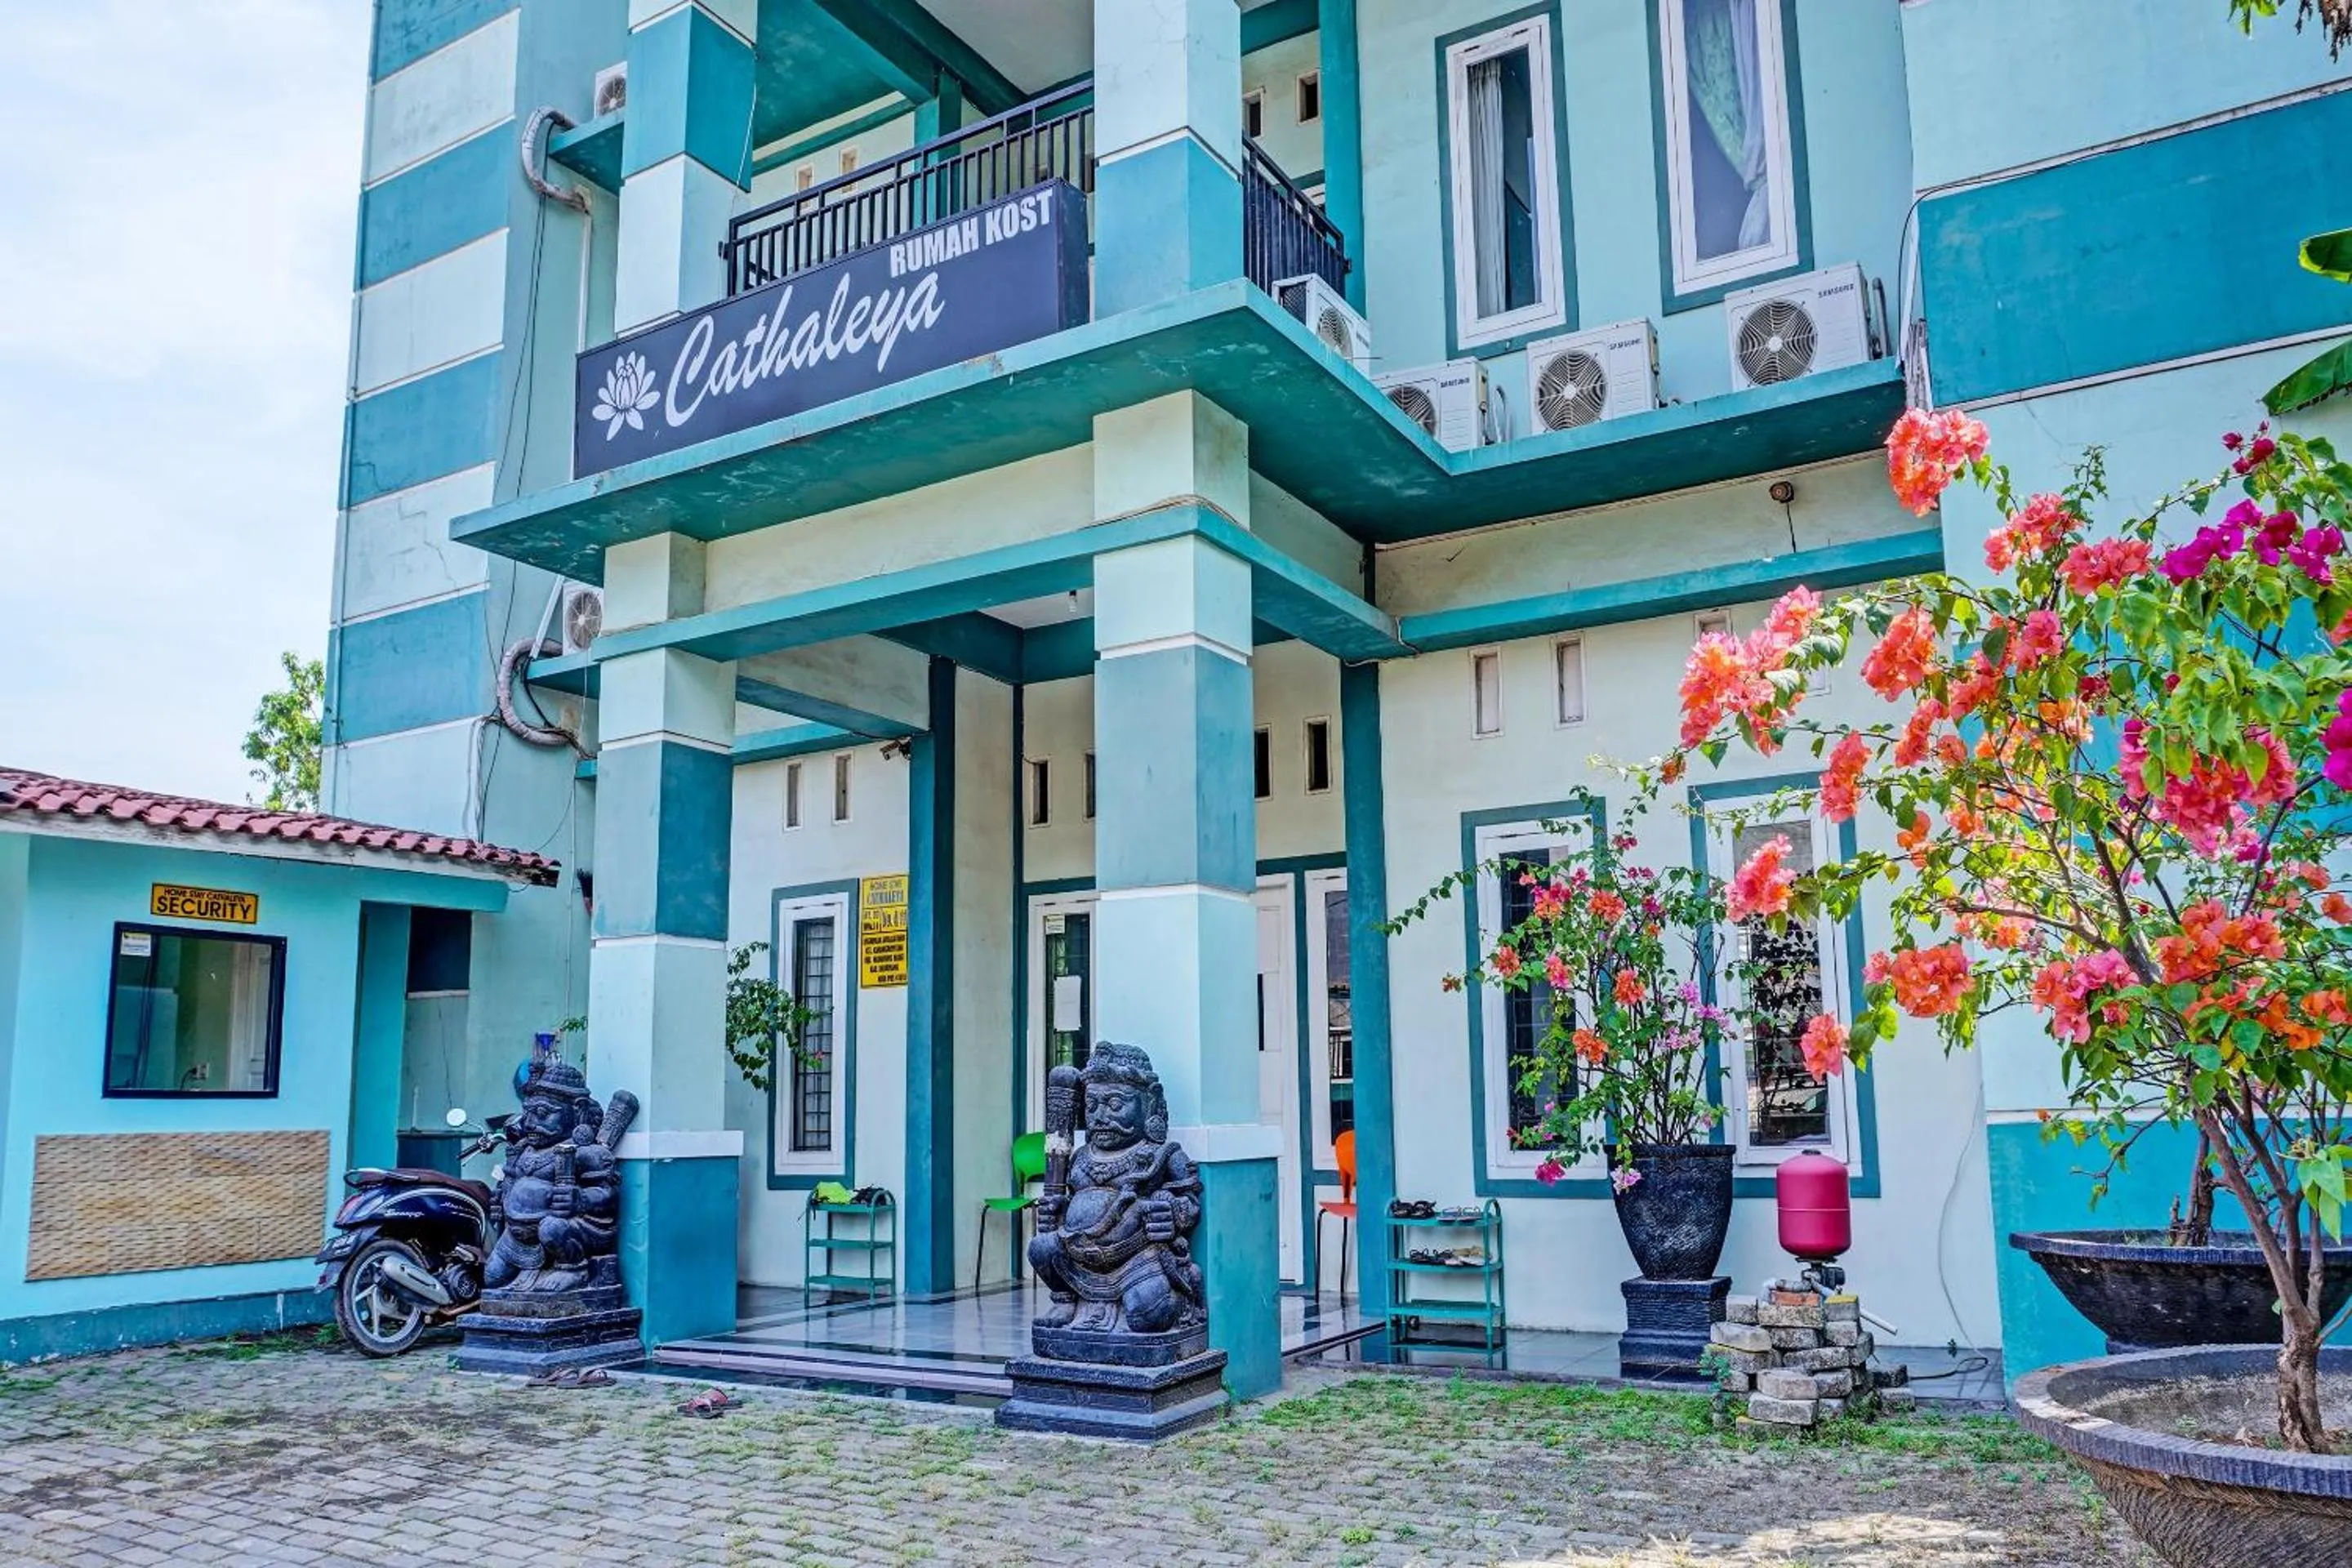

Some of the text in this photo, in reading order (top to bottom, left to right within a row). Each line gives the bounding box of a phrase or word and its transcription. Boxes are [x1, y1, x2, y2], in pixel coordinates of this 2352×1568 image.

[890, 189, 1054, 278] RUMAH KOST
[1818, 283, 1854, 298] SAMSUNG
[665, 273, 945, 427] Cathaleya
[164, 889, 186, 898] HOME
[157, 896, 252, 920] SECURITY
